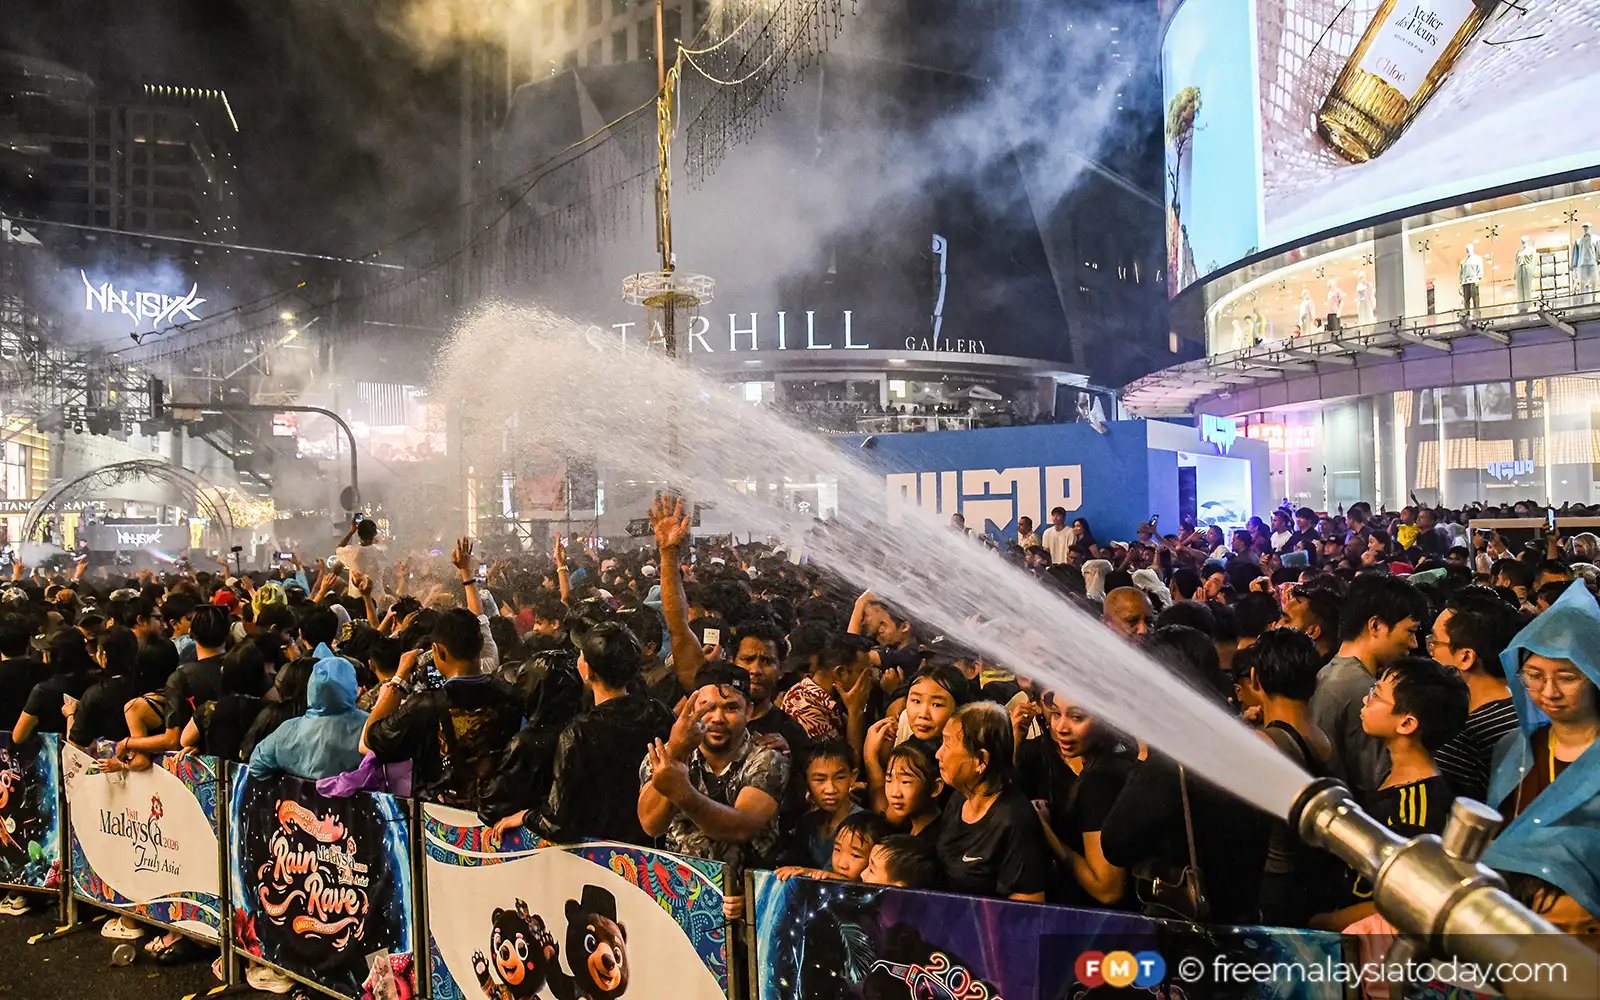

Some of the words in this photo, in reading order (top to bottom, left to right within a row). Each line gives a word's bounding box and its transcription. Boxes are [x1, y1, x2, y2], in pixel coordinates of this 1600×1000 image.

[1407, 18, 1438, 46] Fleurs
[1408, 5, 1443, 30] Atelier
[905, 336, 987, 353] GALLERY
[163, 837, 179, 851] 2026
[134, 845, 159, 873] Truly
[161, 859, 180, 875] Asia
[274, 836, 318, 884] Rain
[304, 872, 360, 921] Rave
[923, 952, 1004, 1000] 202
